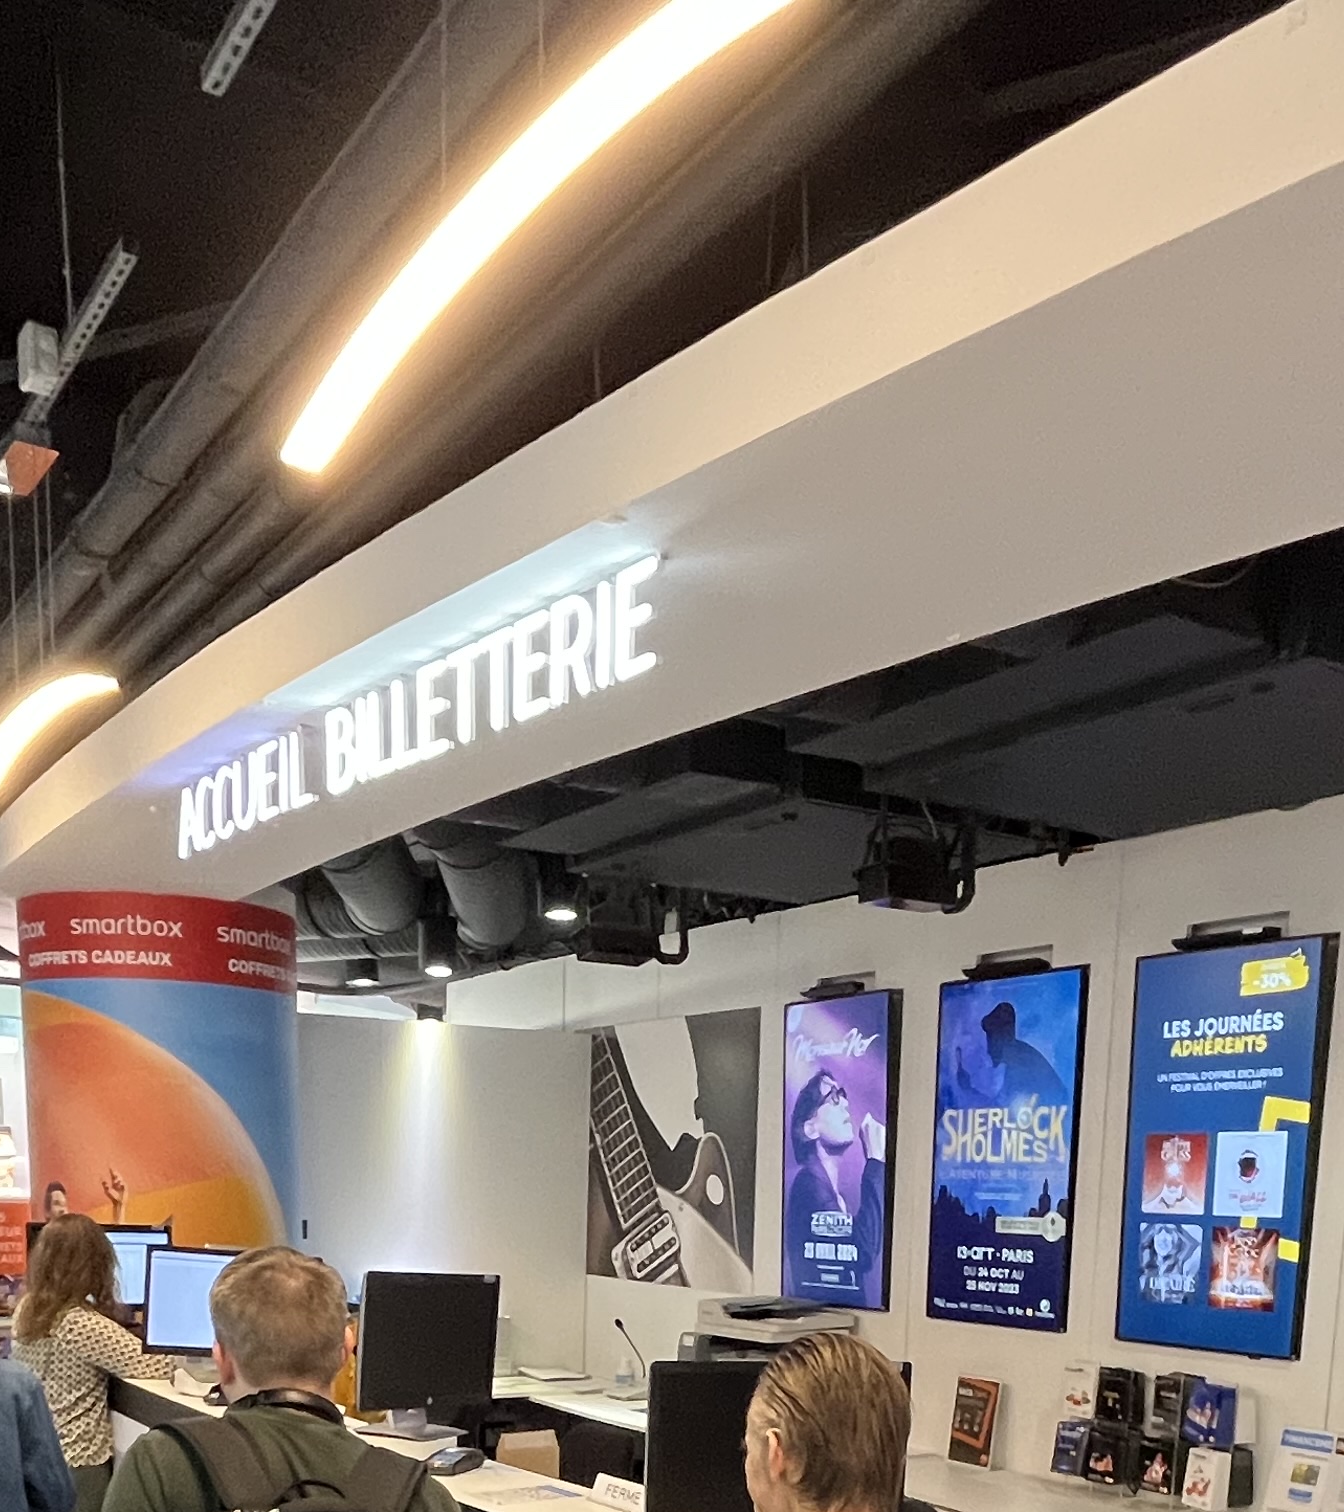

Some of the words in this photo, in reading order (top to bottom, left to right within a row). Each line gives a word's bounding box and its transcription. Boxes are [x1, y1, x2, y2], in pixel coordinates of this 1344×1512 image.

[177, 730, 316, 860] ACCUEIL
[325, 555, 659, 795] BILLETTERIE
[70, 914, 184, 938] smartbox
[28, 950, 88, 967] COFFRETS
[91, 949, 173, 967] CADEAUX
[1163, 1019, 1191, 1039] LES
[1194, 1009, 1284, 1037] JOURNÉES
[1170, 1033, 1268, 1058] ADHÉRENTS
[942, 1094, 1067, 1162] SHERLOCK
[957, 1130, 1049, 1163] HOLMES
[1001, 1248, 1034, 1263] PARIS
[990, 1268, 1010, 1279] OCT
